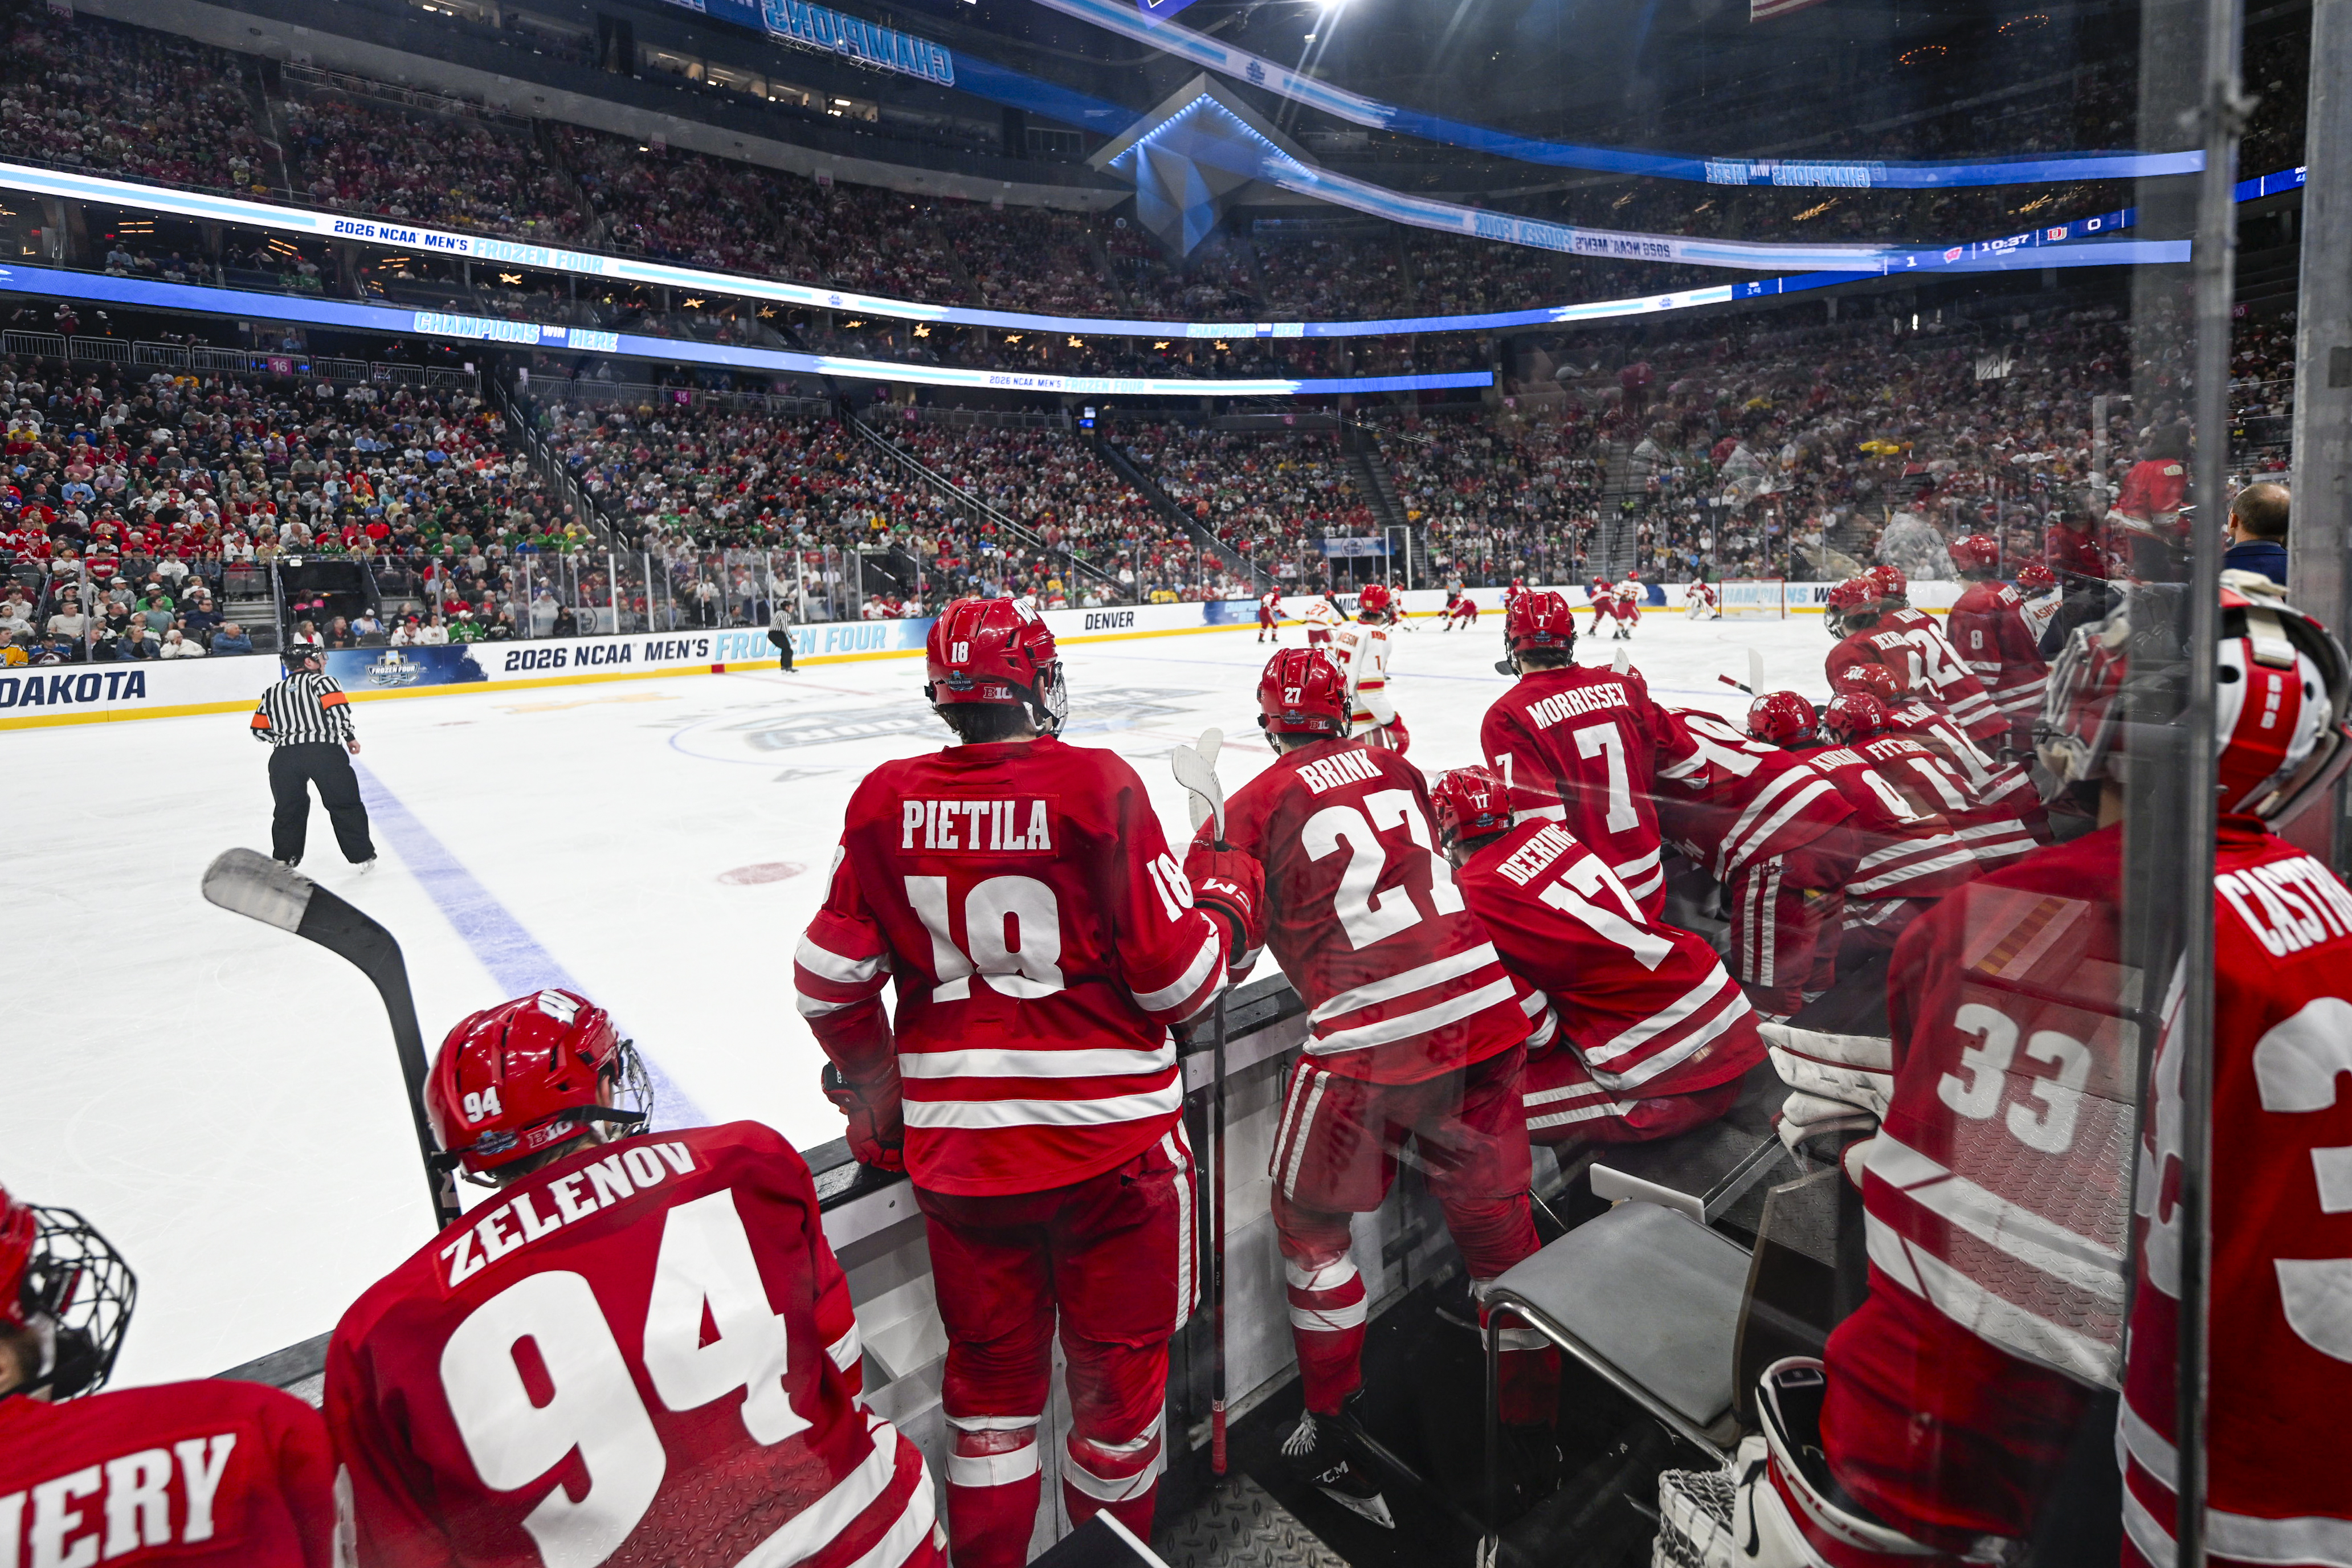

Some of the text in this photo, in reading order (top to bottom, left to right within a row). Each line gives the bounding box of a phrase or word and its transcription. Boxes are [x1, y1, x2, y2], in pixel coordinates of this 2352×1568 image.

[2087, 218, 2101, 231] 0
[334, 220, 374, 238] 2026
[424, 234, 468, 251] MEN'S
[472, 238, 549, 266] FROZEN
[555, 250, 604, 273] FOUR
[1981, 234, 2029, 252] 10:37
[1906, 256, 1918, 267] 1
[414, 311, 619, 353] CHAMPIONS WIN HERE
[1186, 323, 1256, 338] CHAMPIONS
[1272, 323, 1305, 337] HERE
[273, 361, 288, 372] 16
[989, 375, 1011, 385] 2026
[1064, 377, 1110, 393] FROZEN
[1113, 379, 1146, 394] FOUR
[1623, 589, 1638, 600] 23
[1085, 611, 1134, 631] DENVER
[1310, 604, 1329, 616] 27
[1537, 615, 1545, 627] 7
[1892, 607, 1926, 623] KNOX
[505, 647, 567, 672] 2026
[645, 638, 709, 662] MEN'S
[825, 624, 887, 654] FOUR
[951, 641, 969, 663] 18
[1970, 630, 1983, 650] 8
[0, 670, 146, 708] DAKOTA
[1284, 687, 1302, 704] 27
[1525, 683, 1629, 730] MORRISSEY
[1796, 713, 1804, 724] 9
[1871, 713, 1881, 724] 13
[1295, 748, 1383, 795] BRINK
[1495, 752, 1514, 790] 7
[1573, 721, 1640, 834] 7
[1475, 793, 1491, 809] 17
[902, 799, 1052, 850] PIETILA
[1301, 788, 1466, 951] 27
[1496, 823, 1578, 887] DEERING
[1146, 852, 1195, 924] 18
[1538, 852, 1675, 973] 17
[904, 875, 1067, 1004] 18
[463, 1085, 503, 1124] 94
[440, 1141, 696, 1289] ZELENOV
[440, 1187, 814, 1568] 94
